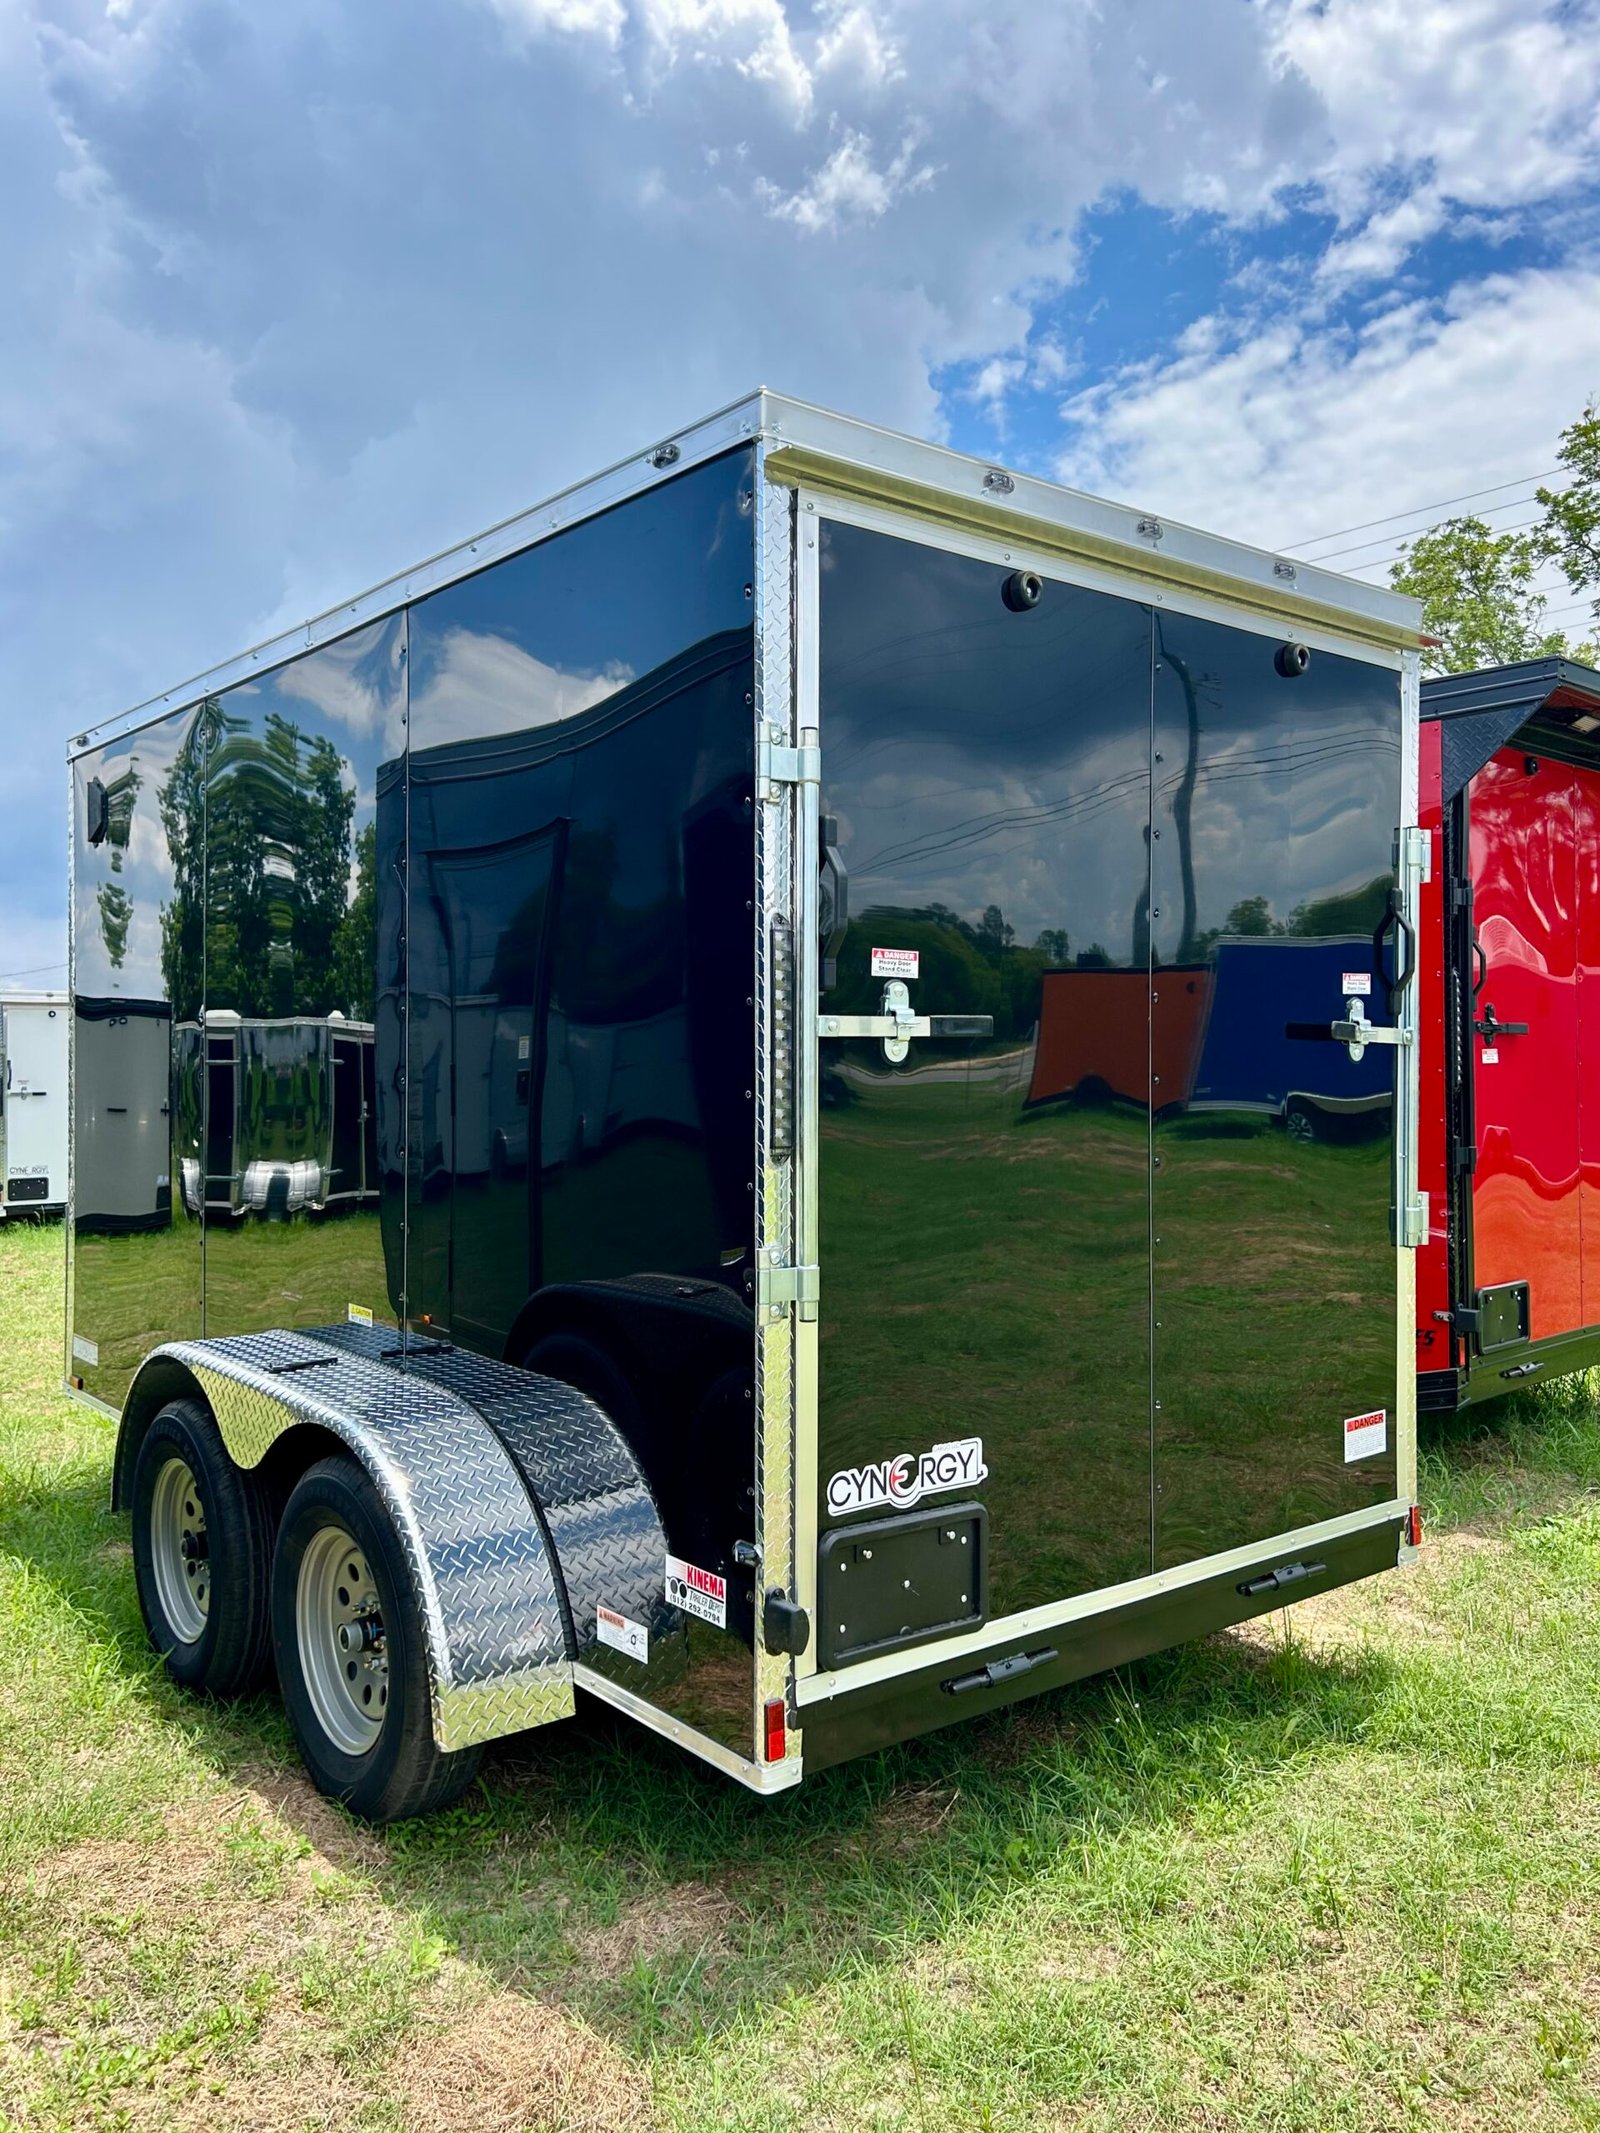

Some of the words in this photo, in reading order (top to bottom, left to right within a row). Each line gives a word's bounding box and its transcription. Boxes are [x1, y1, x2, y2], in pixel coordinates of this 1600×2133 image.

[884, 951, 915, 960] DANGER
[1354, 1413, 1384, 1430] DANGER
[830, 1449, 974, 1507] CYNERGY
[687, 1565, 724, 1599] KINEMA
[670, 1593, 687, 1608] (912)
